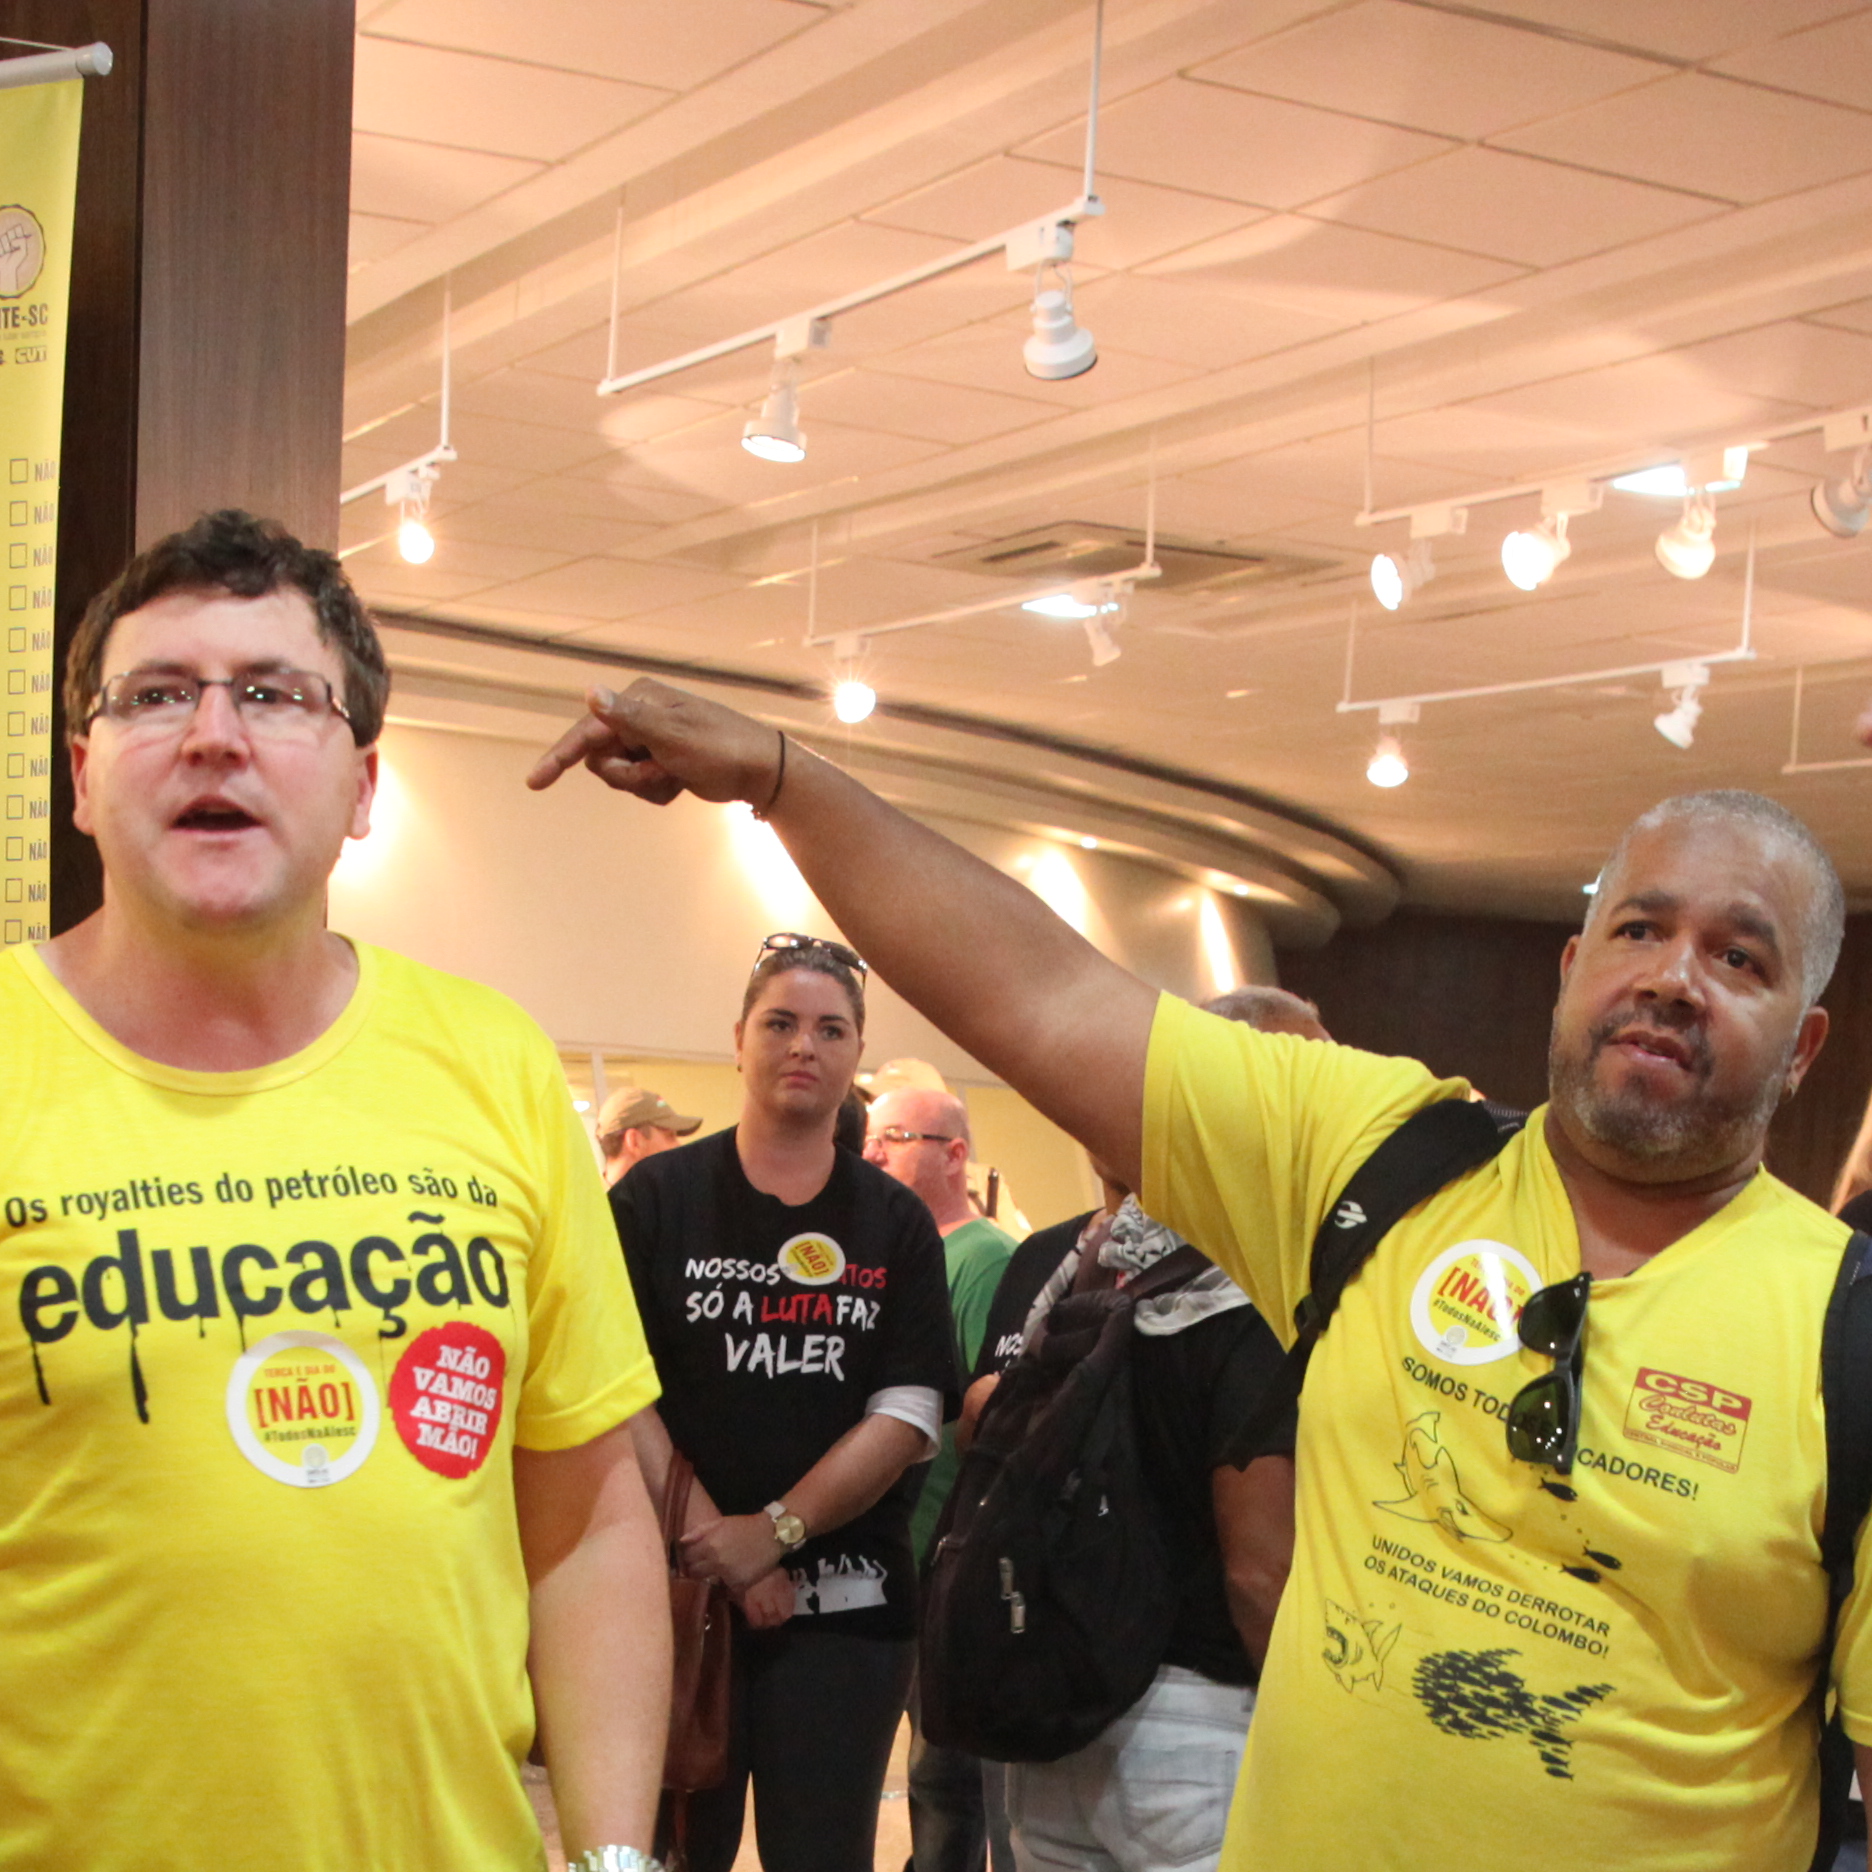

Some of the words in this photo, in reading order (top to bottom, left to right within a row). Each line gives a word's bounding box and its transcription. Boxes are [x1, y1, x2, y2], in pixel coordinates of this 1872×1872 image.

[34, 460, 56, 482] NÃO
[34, 502, 55, 524] NÃO
[33, 544, 54, 567] NÃO
[32, 586, 53, 609] NÃO
[32, 629, 51, 651] NÃO
[31, 671, 50, 693] NÃO
[31, 713, 49, 735] NÃO
[30, 755, 48, 777] NÃO
[29, 797, 48, 819] NÃO
[29, 839, 47, 861] NÃO
[28, 880, 47, 902] NÃO
[28, 922, 47, 941] NÃO
[5, 1196, 48, 1229] Os
[60, 1175, 204, 1222] royalties
[215, 1171, 254, 1205] do
[265, 1165, 398, 1209] petróleo
[406, 1166, 458, 1199] são
[466, 1174, 499, 1208] da
[18, 1210, 512, 1348] educação
[684, 1256, 781, 1287] NOSSOS
[685, 1284, 724, 1323] SÓ
[732, 1291, 753, 1325] A
[761, 1292, 833, 1326] LUTA
[836, 1296, 881, 1331] FAZ
[436, 1345, 490, 1380] NÃO
[725, 1332, 846, 1381] VALER
[254, 1377, 356, 1428] [NÃO]
[412, 1365, 498, 1412] VAMOS
[1645, 1374, 1743, 1410] CSP
[409, 1395, 488, 1436] ABRIR
[1401, 1356, 1469, 1401] SOMOS
[1473, 1388, 1511, 1422] TOD
[1577, 1448, 1700, 1501] CADORES!
[1639, 1393, 1737, 1437] Conlutas
[1645, 1413, 1722, 1451] Educação
[415, 1421, 480, 1461] MÃO!
[1372, 1534, 1438, 1573] UNIDOS
[1441, 1565, 1504, 1598] VAMOS
[1506, 1588, 1612, 1638] DERROTAR
[1364, 1555, 1387, 1575] OS
[1388, 1564, 1470, 1608] ATAQUES
[1471, 1598, 1501, 1618] DO
[1504, 1609, 1610, 1659] COLOMBO!
